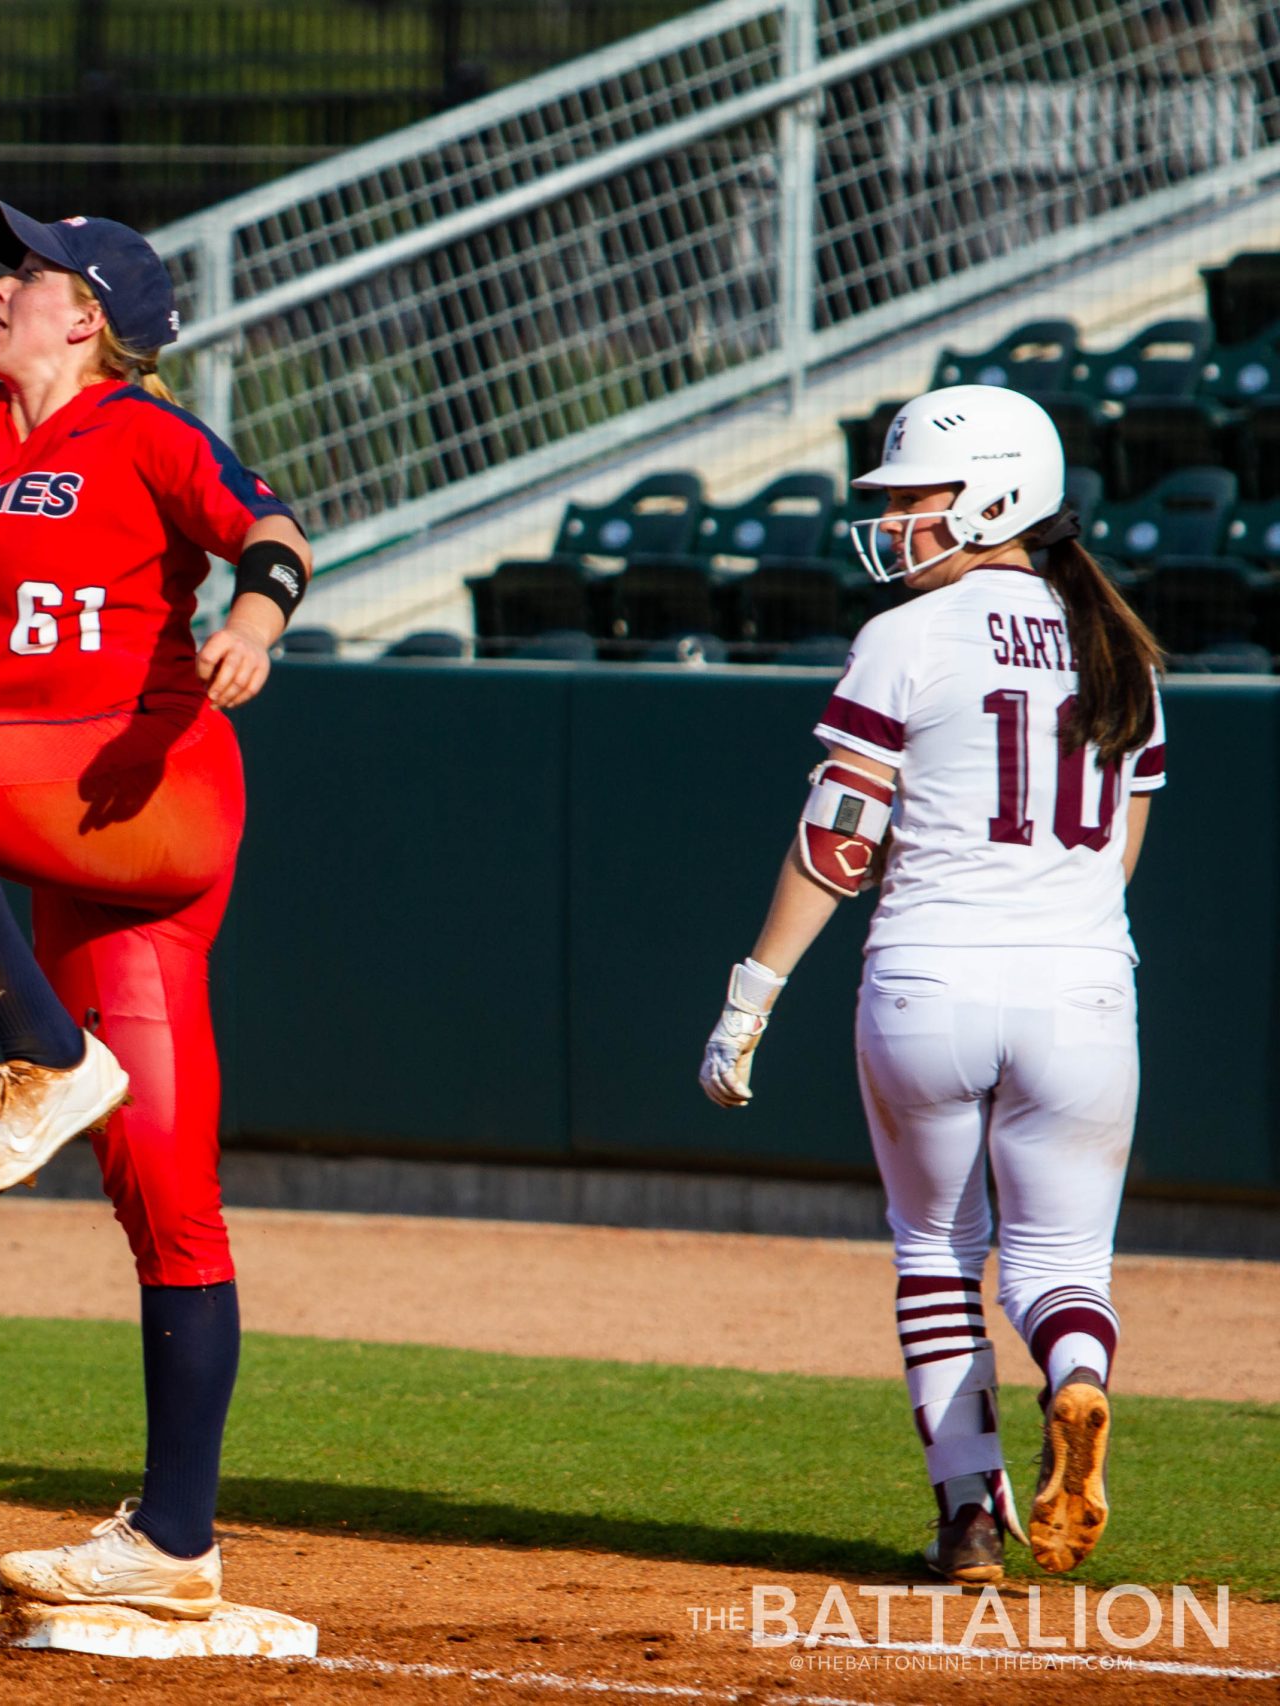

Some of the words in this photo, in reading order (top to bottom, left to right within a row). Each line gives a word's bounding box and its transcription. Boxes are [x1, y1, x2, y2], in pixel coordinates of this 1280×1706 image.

[9, 580, 107, 656] 61
[987, 613, 1079, 672] SART
[982, 688, 1121, 852] 10
